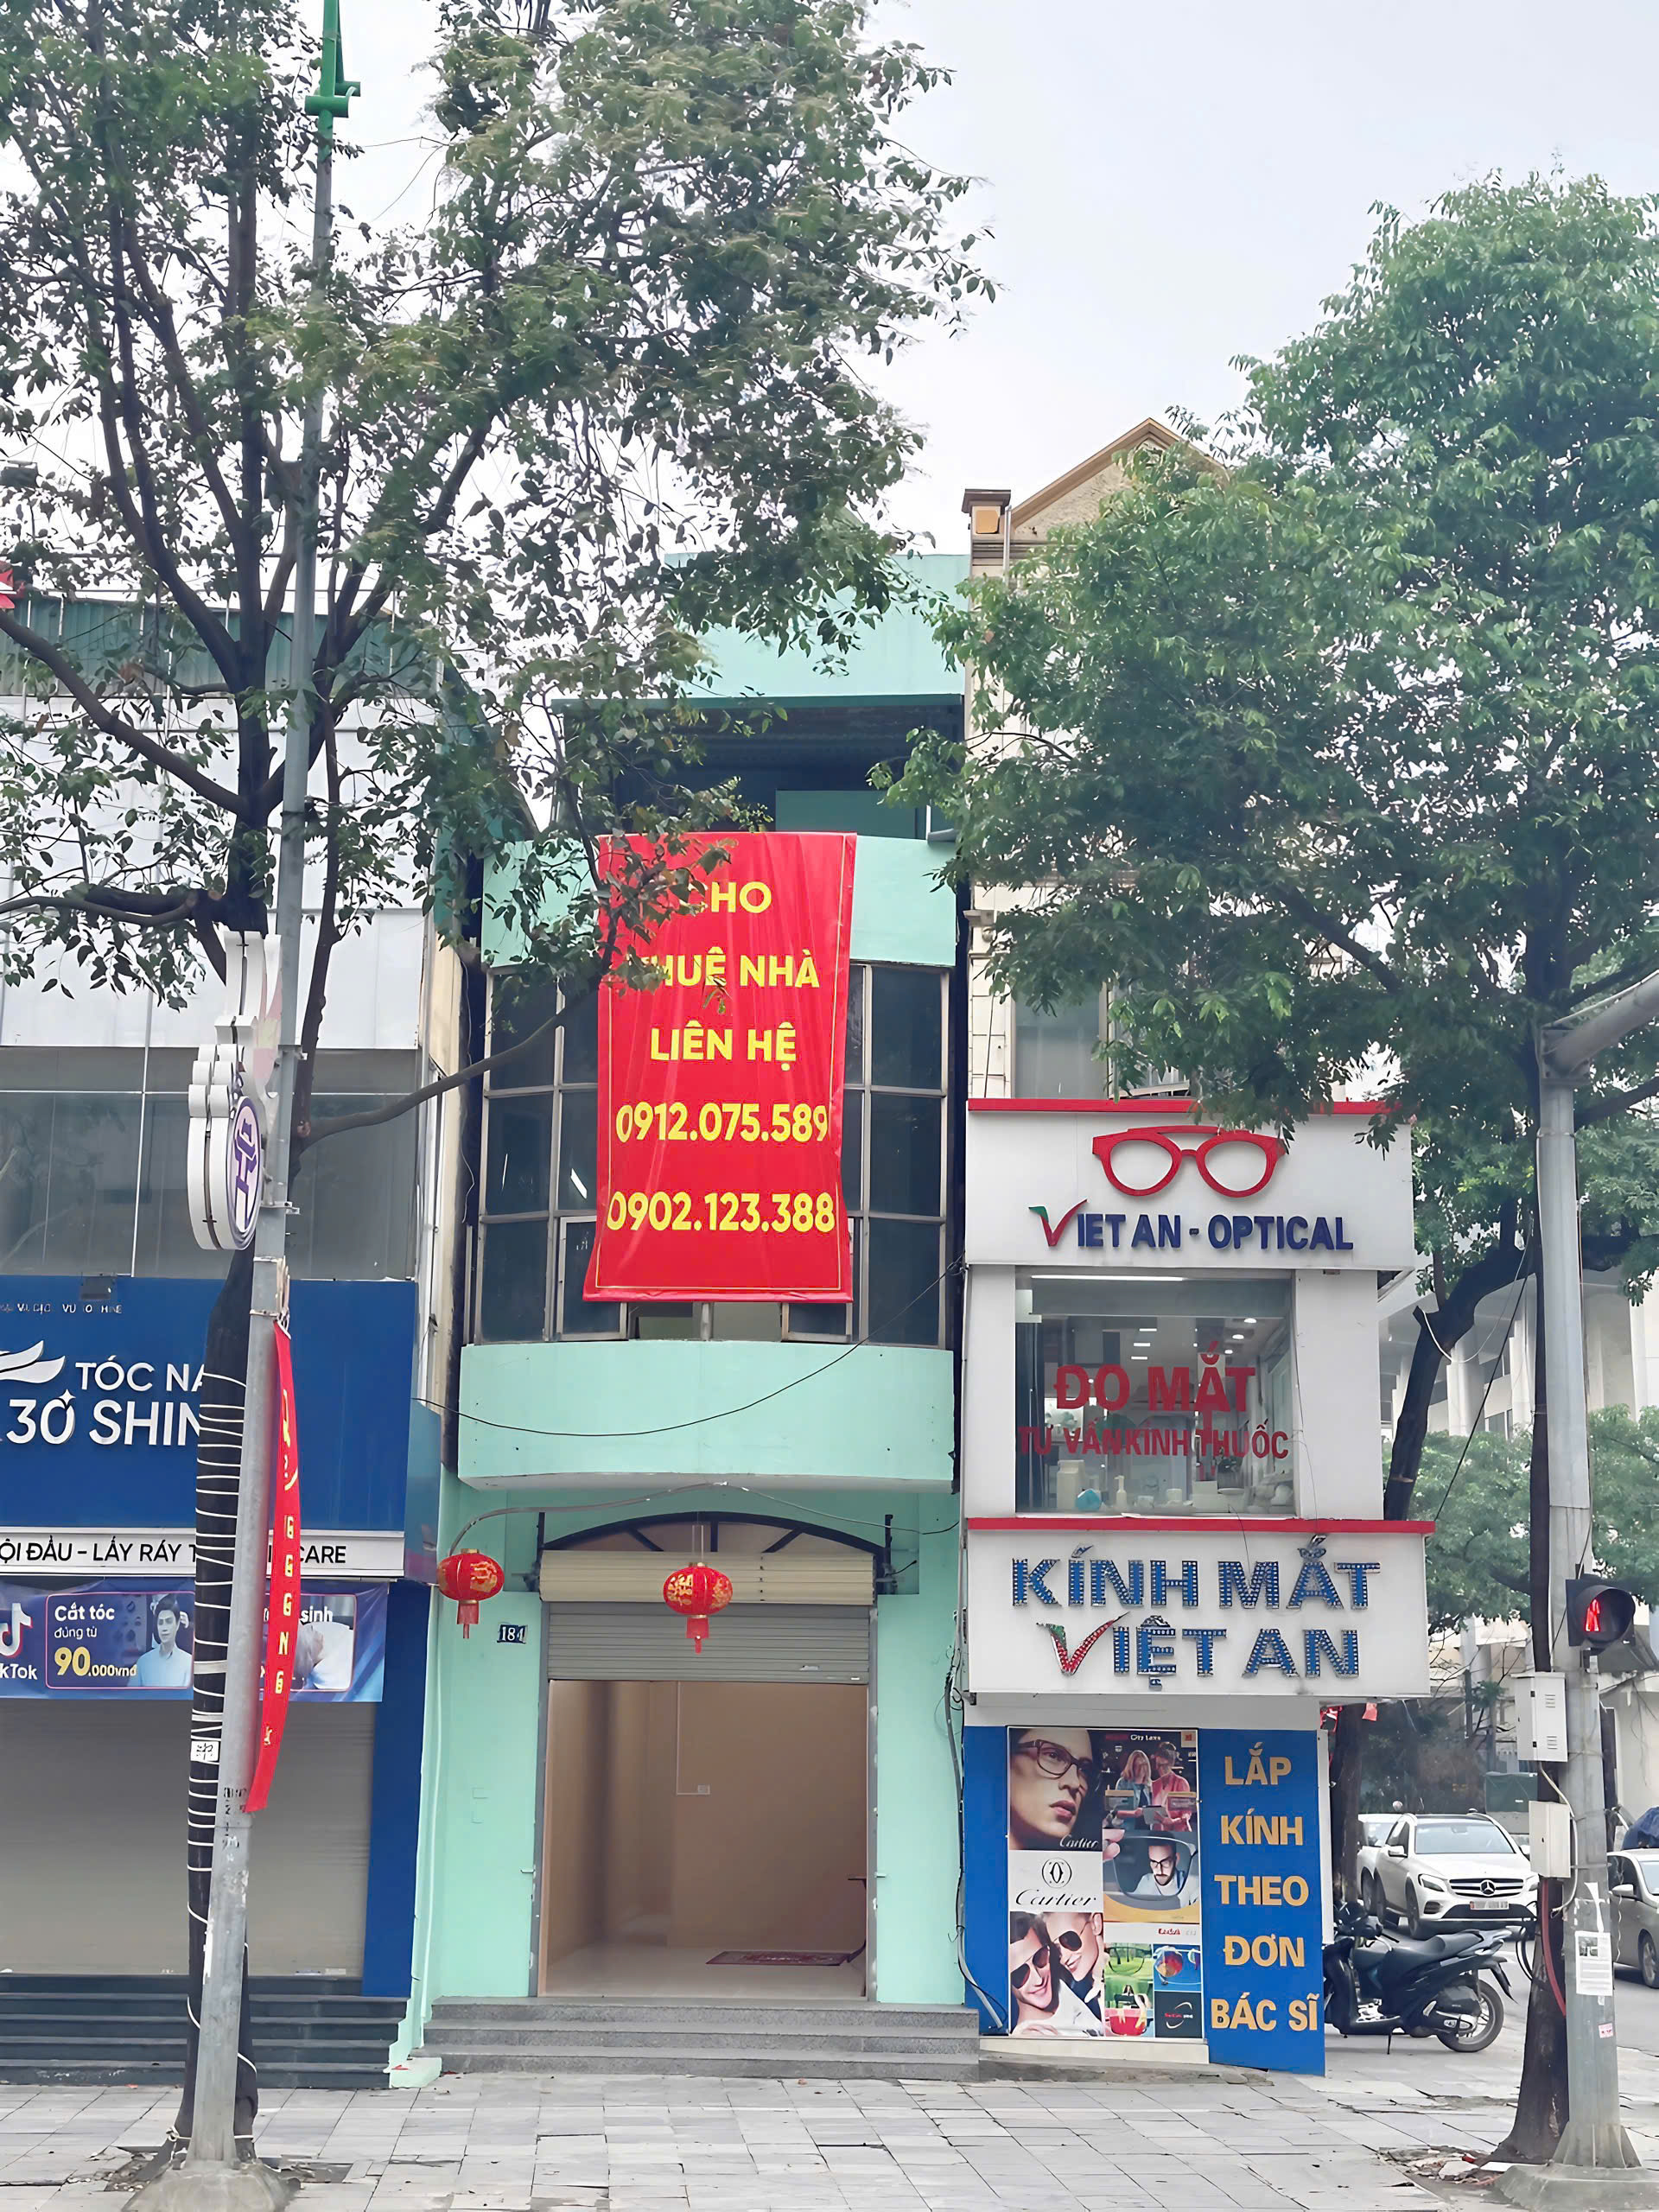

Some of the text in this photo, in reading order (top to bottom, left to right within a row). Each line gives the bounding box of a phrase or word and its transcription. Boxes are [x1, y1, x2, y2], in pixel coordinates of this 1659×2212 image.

[678, 881, 772, 914] HO
[628, 947, 820, 988] HUÊ NHÀ
[650, 1020, 797, 1071] LIÊN HỆ
[616, 1102, 828, 1142] 0912.075.589
[607, 1192, 836, 1232] 0902.123.388
[1028, 1199, 1126, 1248] VIET
[1131, 1214, 1181, 1249] AN
[1207, 1214, 1354, 1250] OPTICAL
[75, 1355, 155, 1391] TÓC
[1053, 1340, 1256, 1413] ĐO MẮT
[89, 1399, 201, 1446] SHIN
[0, 1538, 22, 1564] ỘI
[92, 1535, 133, 1562] LẤY
[139, 1539, 182, 1562] RÁY
[1013, 1534, 1381, 1610] KÍNH MẮT
[89, 1603, 115, 1620] tóc
[300, 1605, 334, 1624] sinh
[1036, 1611, 1360, 1689] VIỆT AN
[0, 1663, 38, 1680] kTok
[1224, 1742, 1292, 1786] LẮP
[1220, 1808, 1303, 1846] KÍNH
[1213, 1875, 1309, 1907] THEO
[1223, 1934, 1305, 1967] ĐƠN
[1211, 1993, 1319, 2031] BÁC SĨ
